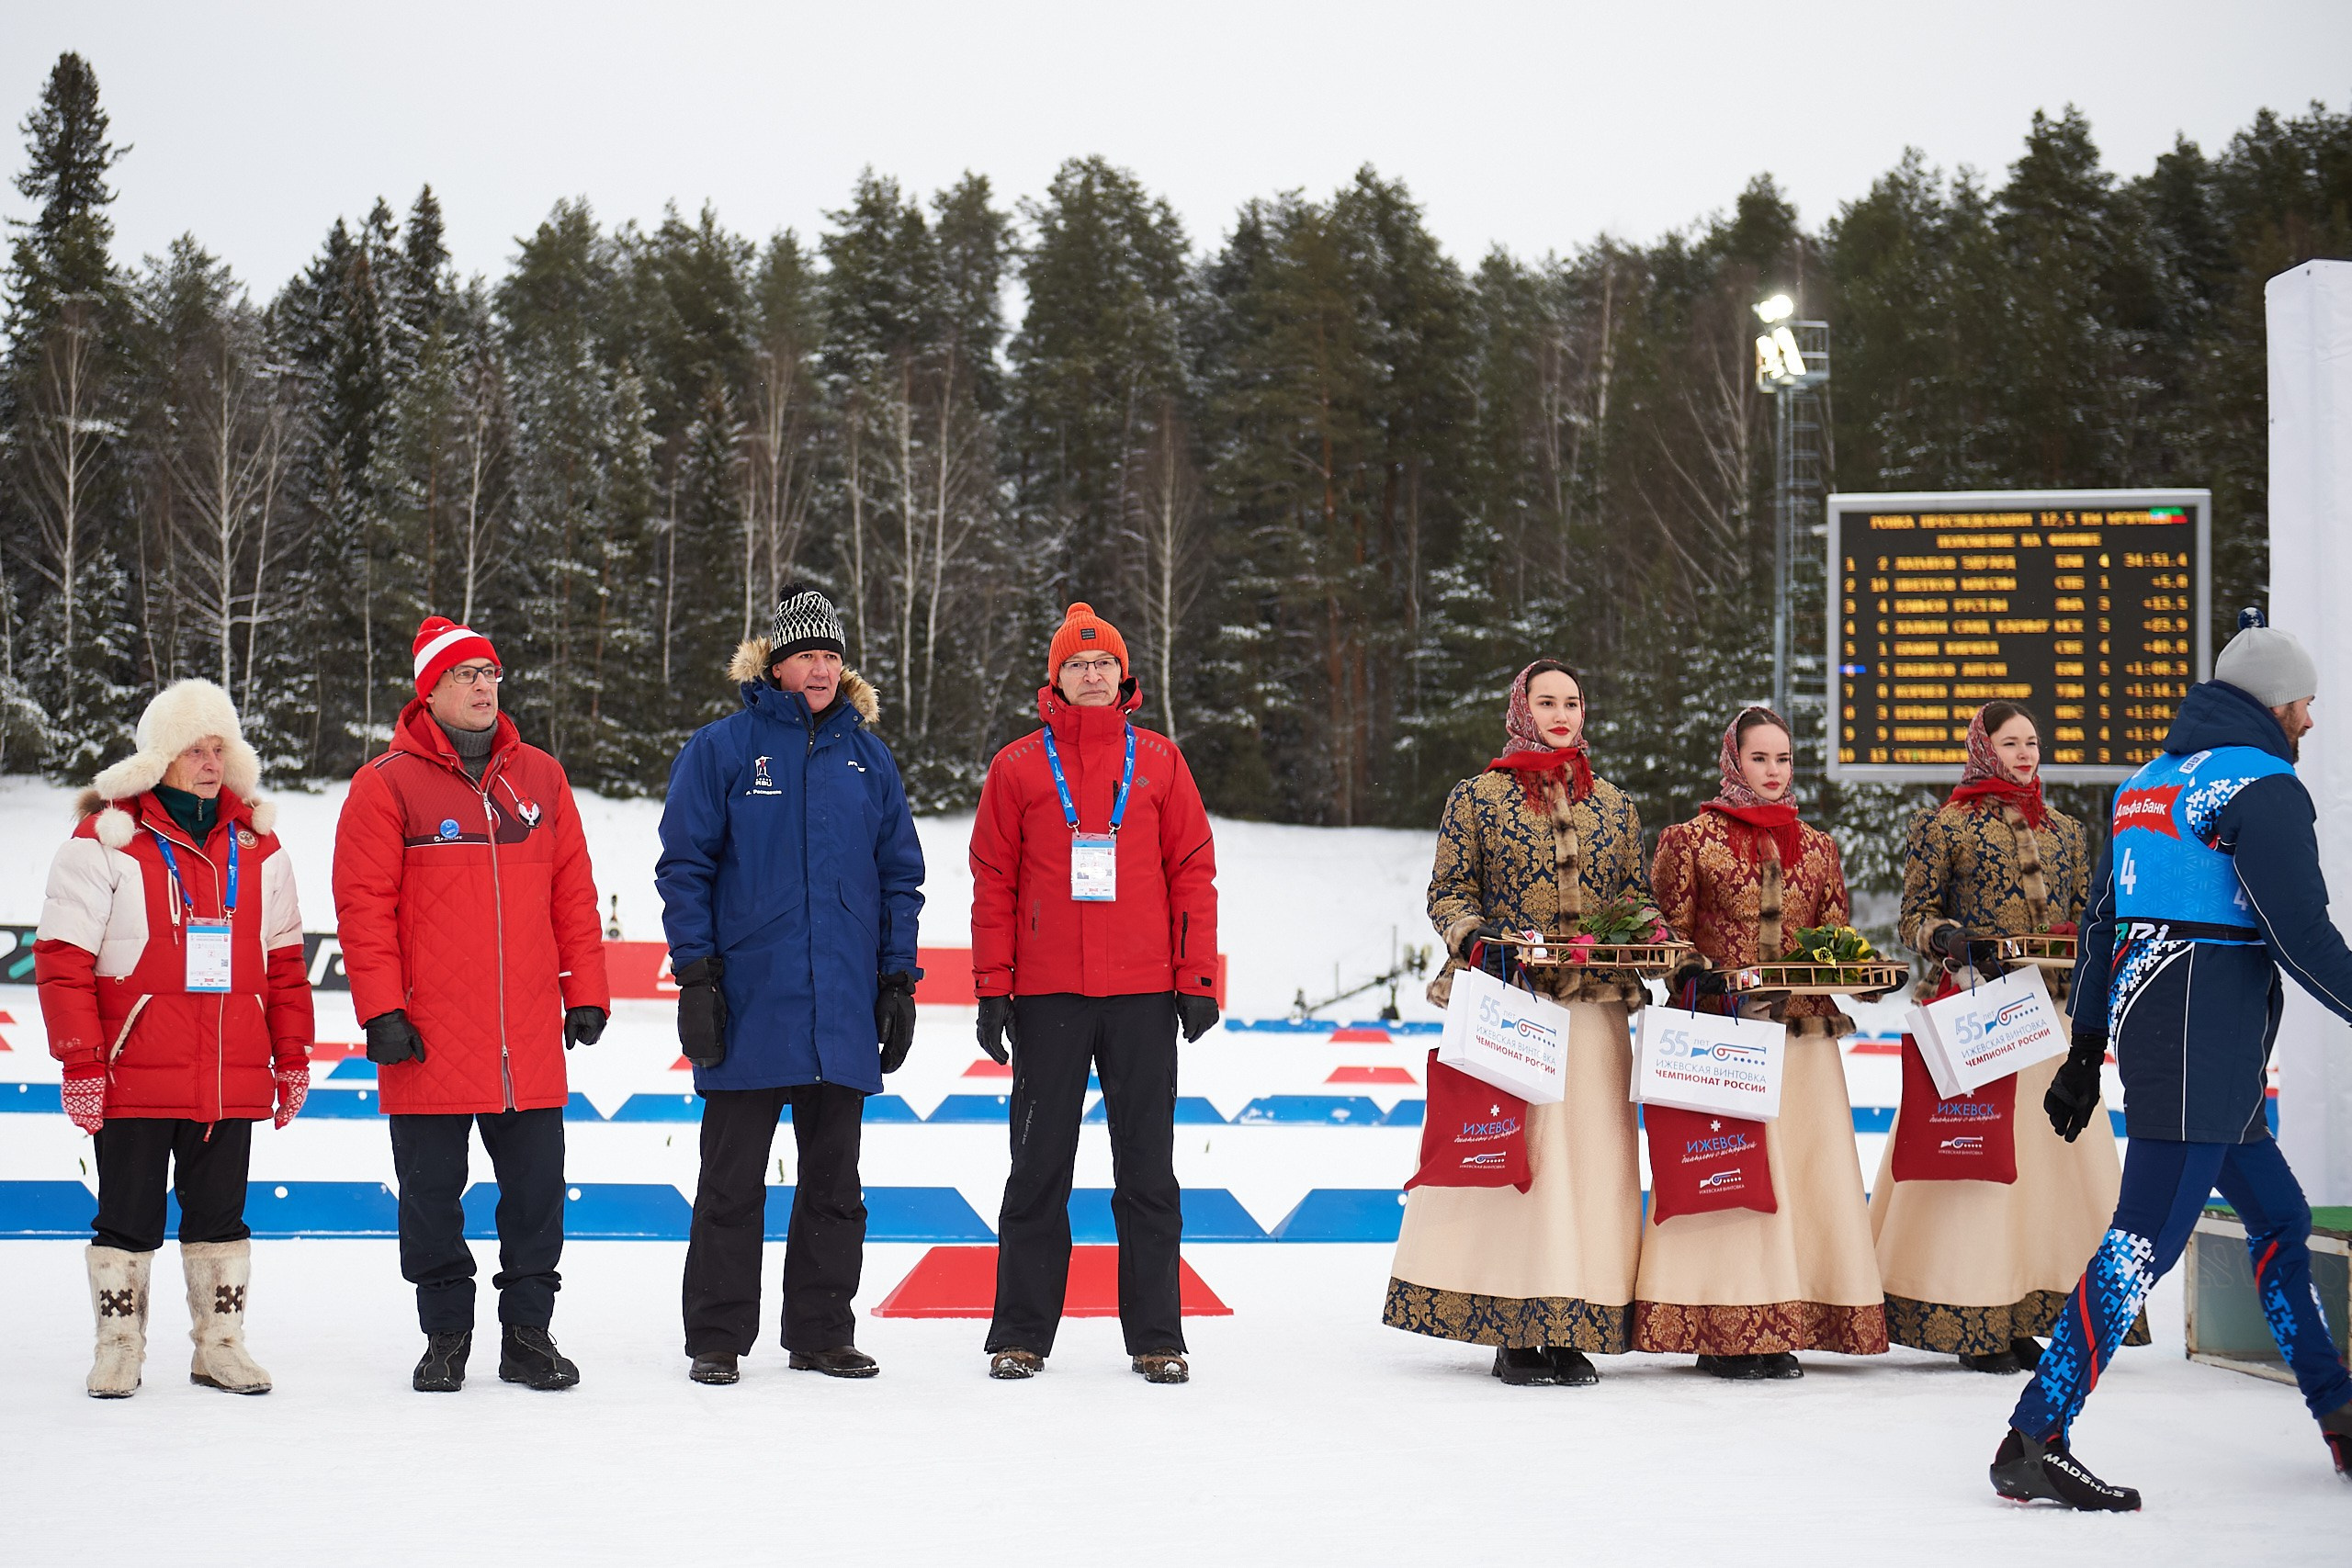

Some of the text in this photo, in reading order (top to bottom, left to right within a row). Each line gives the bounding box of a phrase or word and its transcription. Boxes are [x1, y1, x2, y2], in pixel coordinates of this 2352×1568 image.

[1847, 558, 1855, 571] 1
[1878, 557, 1888, 570] 2
[1845, 578, 1856, 592] 2
[2115, 798, 2166, 819] Альфа Банк
[2120, 848, 2136, 895] 4
[2233, 886, 2248, 911] 4
[1479, 995, 1500, 1027] 55
[1476, 1024, 1516, 1049] ИЖЕВСКАЯ
[1955, 1011, 1984, 1044] 55
[1962, 1019, 2047, 1059] ИЖЕВСКАЯ ВИНТОВКА
[1476, 1034, 1522, 1061] ЧЕМПИОНАТ
[1659, 1029, 1690, 1057] 55
[1966, 1028, 2051, 1067] ЧЕМПИОНАТ РОССИИ
[1656, 1058, 1767, 1084] ИЖЕВСКАЯ ВИНТОВКА
[1656, 1069, 1766, 1093] ЧЕМПИОНАТ РОССИИ
[1938, 1102, 1995, 1116] ИЖЕВСК
[1464, 1117, 1516, 1135] ИЖЕВСК
[1687, 1134, 1747, 1154] ИЖЕВСК
[2042, 1453, 2125, 1499] MADSHUS
